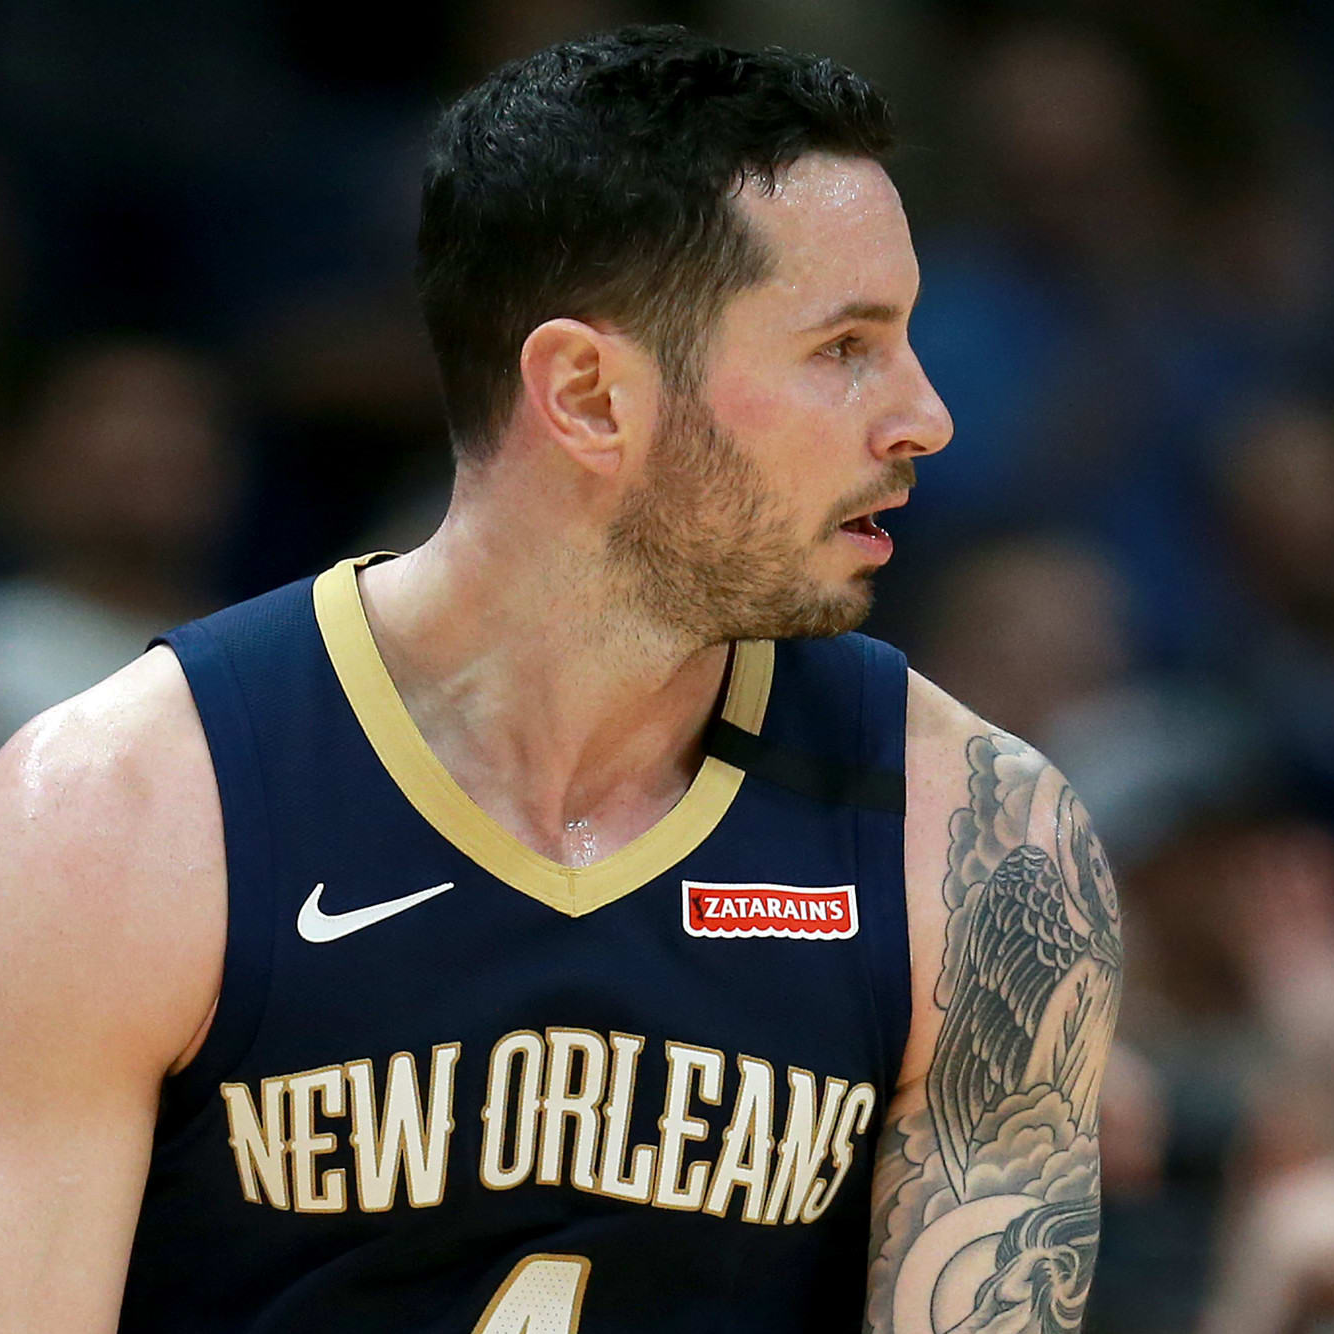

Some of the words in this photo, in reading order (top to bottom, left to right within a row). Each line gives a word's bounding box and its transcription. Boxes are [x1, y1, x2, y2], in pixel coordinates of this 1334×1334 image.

[703, 896, 844, 921] ZATARAIN'S
[220, 1041, 461, 1213] NEW
[479, 1026, 876, 1225] ORLEANS
